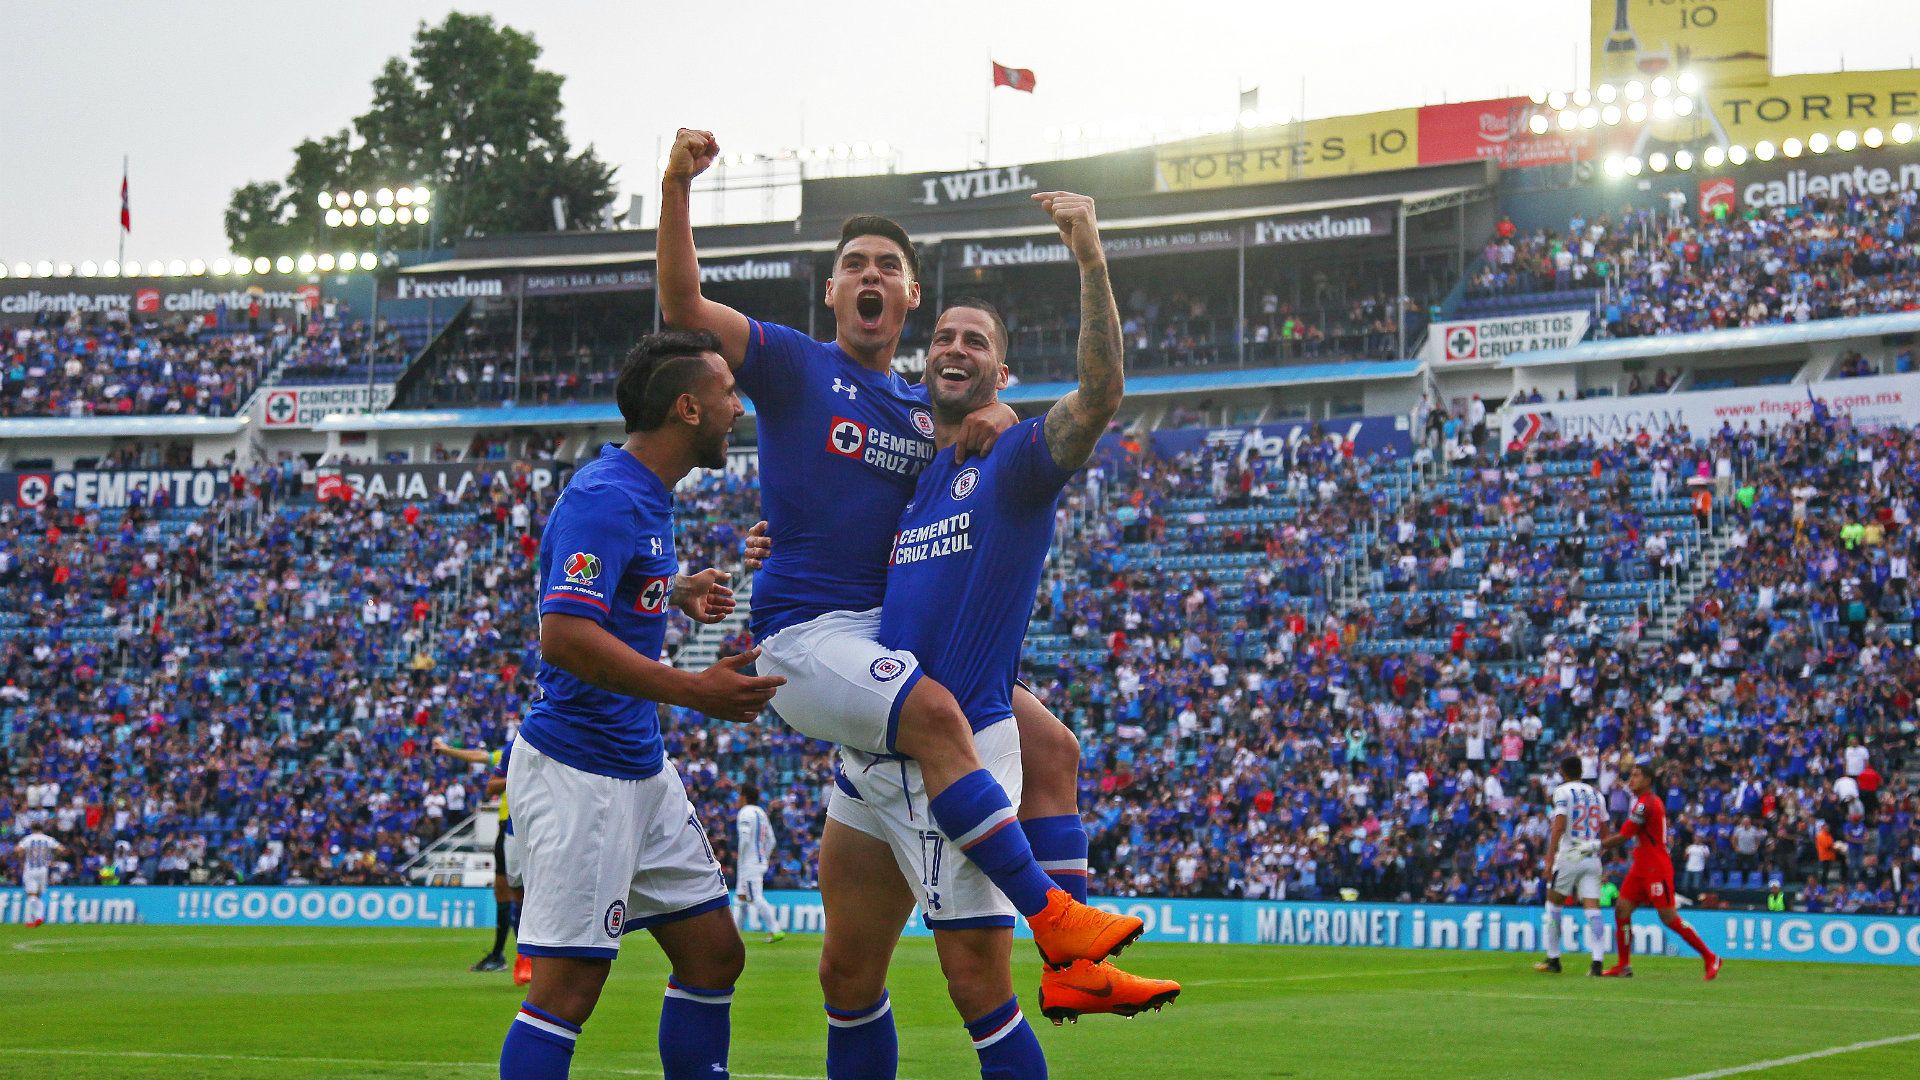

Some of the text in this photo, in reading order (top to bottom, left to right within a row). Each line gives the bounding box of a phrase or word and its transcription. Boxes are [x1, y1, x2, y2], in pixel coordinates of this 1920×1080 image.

[1681, 5, 1717, 28] 10
[1723, 91, 1920, 124] TORRE
[1168, 129, 1408, 182] TORRES 10
[922, 166, 1038, 205] I WILL.
[963, 242, 1070, 267] Freedom
[1254, 215, 1371, 245] Freedom
[398, 276, 502, 299] Freedom
[700, 260, 791, 283] reedom
[1480, 317, 1572, 338] CONCRETOS
[864, 447, 909, 474] CRUZ
[899, 512, 970, 545] CEMENTO
[895, 533, 973, 565] CRUZ AZUL
[919, 830, 944, 886] 17
[1256, 908, 1399, 945] MACRONET
